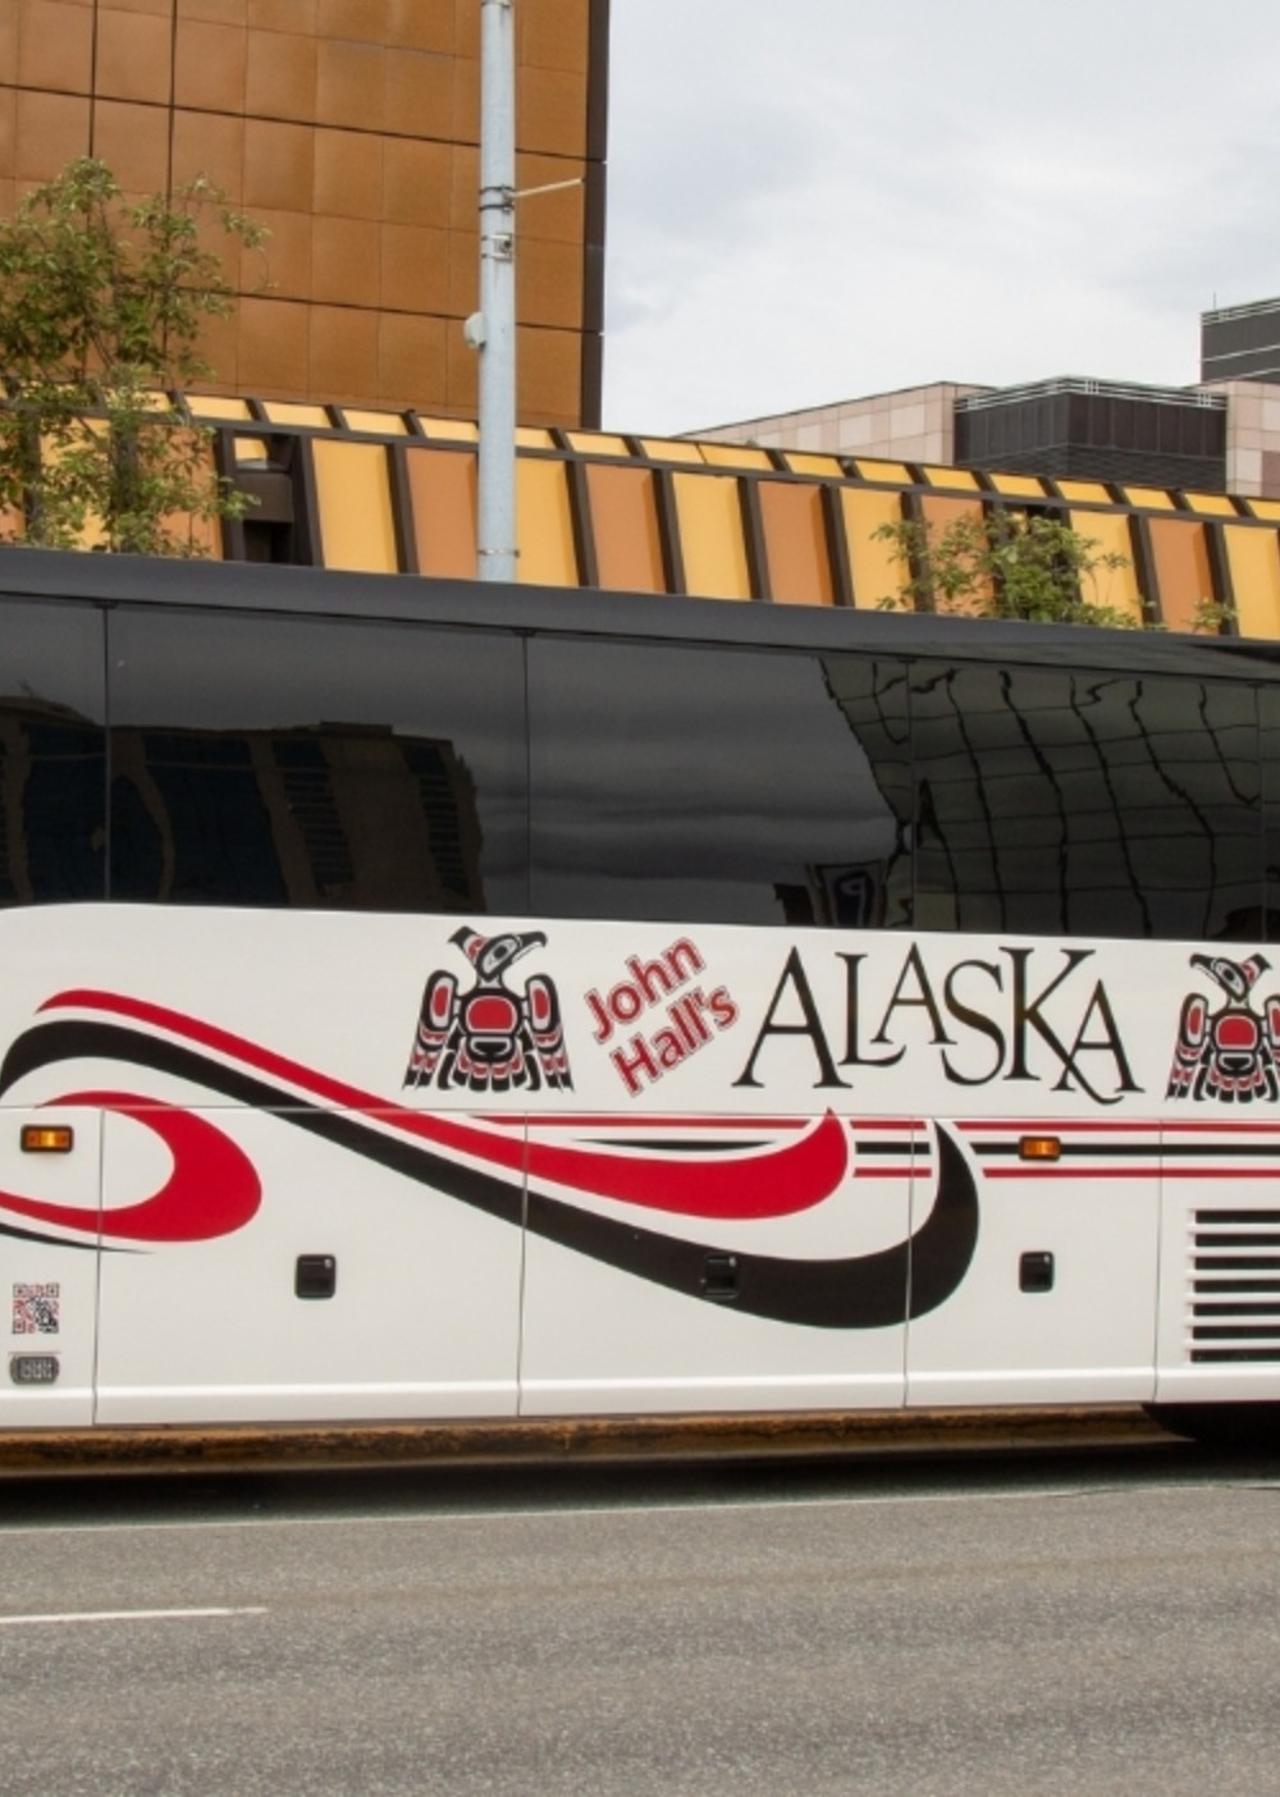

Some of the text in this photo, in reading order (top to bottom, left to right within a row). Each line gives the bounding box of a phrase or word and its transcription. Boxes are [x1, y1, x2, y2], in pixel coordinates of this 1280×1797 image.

[585, 937, 707, 1044] John
[610, 985, 740, 1098] Hall's
[731, 941, 1147, 1106] ALASKA
